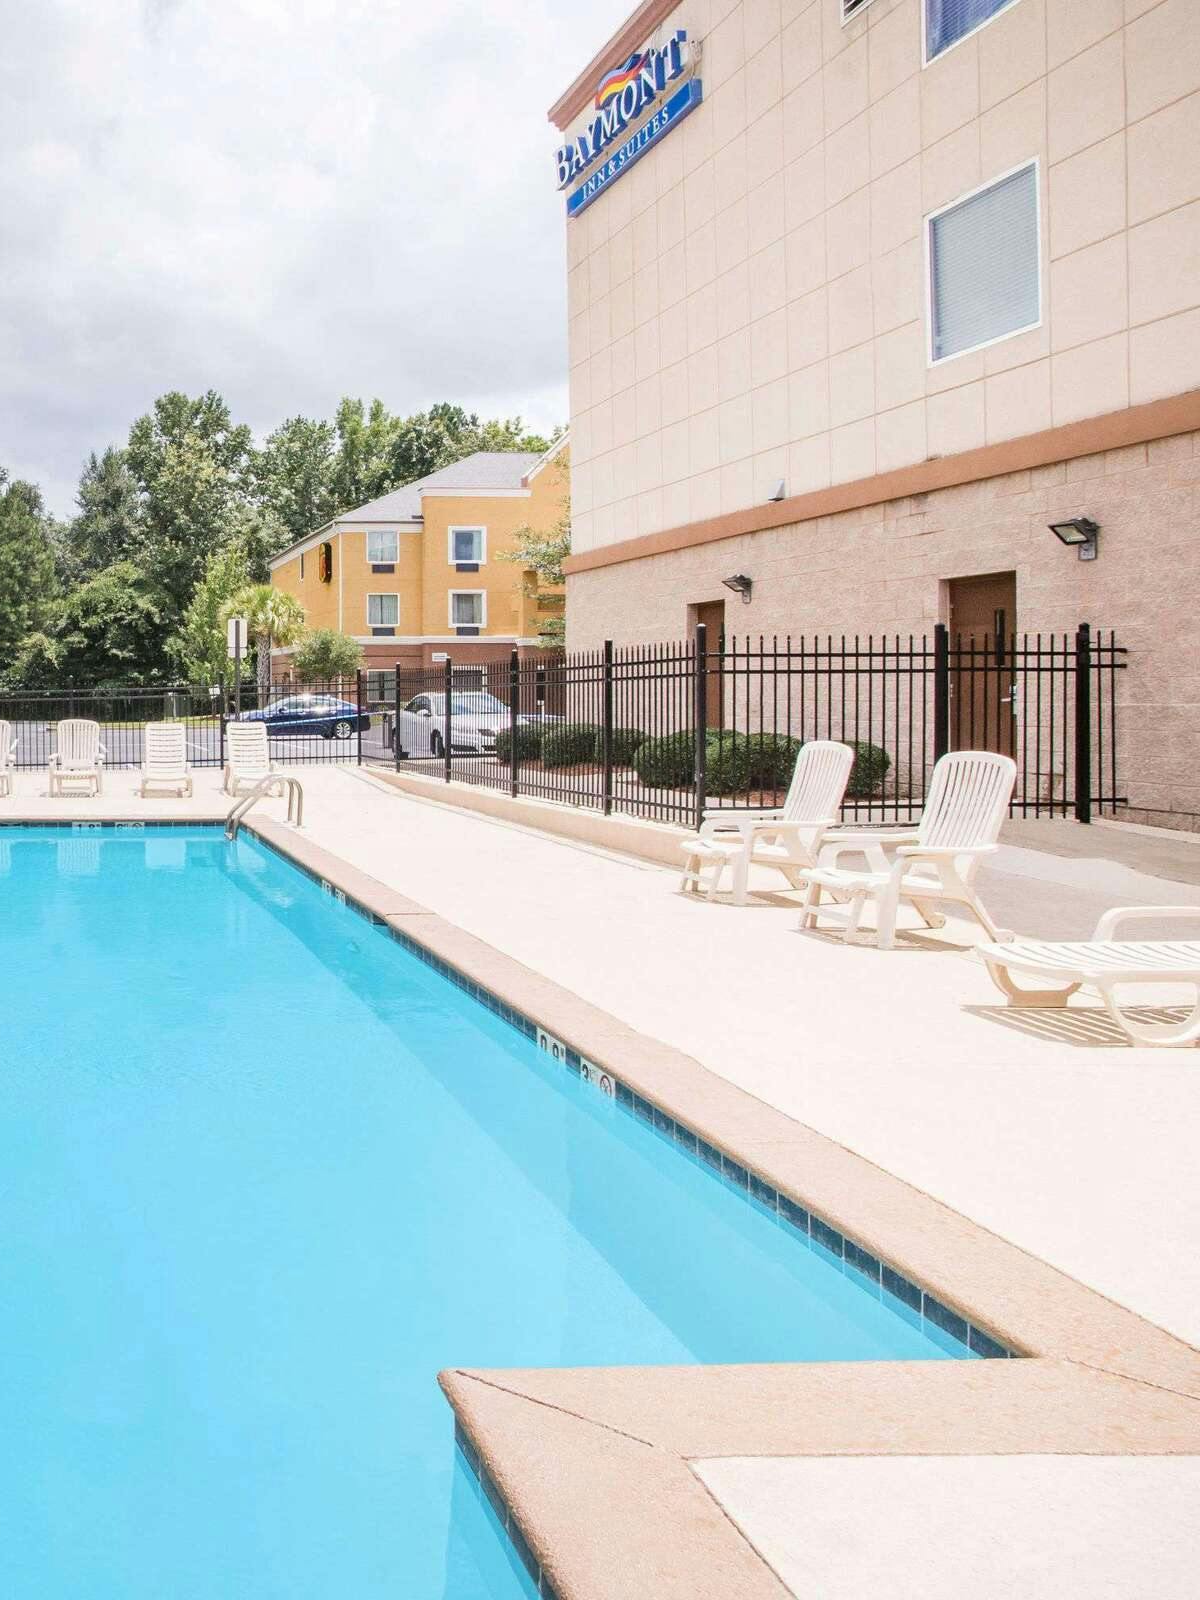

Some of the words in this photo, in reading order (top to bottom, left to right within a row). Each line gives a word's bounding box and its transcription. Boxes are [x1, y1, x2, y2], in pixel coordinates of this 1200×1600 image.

[553, 30, 687, 191] BAYMONT
[582, 169, 607, 200] INN
[608, 159, 618, 176] &
[618, 106, 669, 167] SUITES
